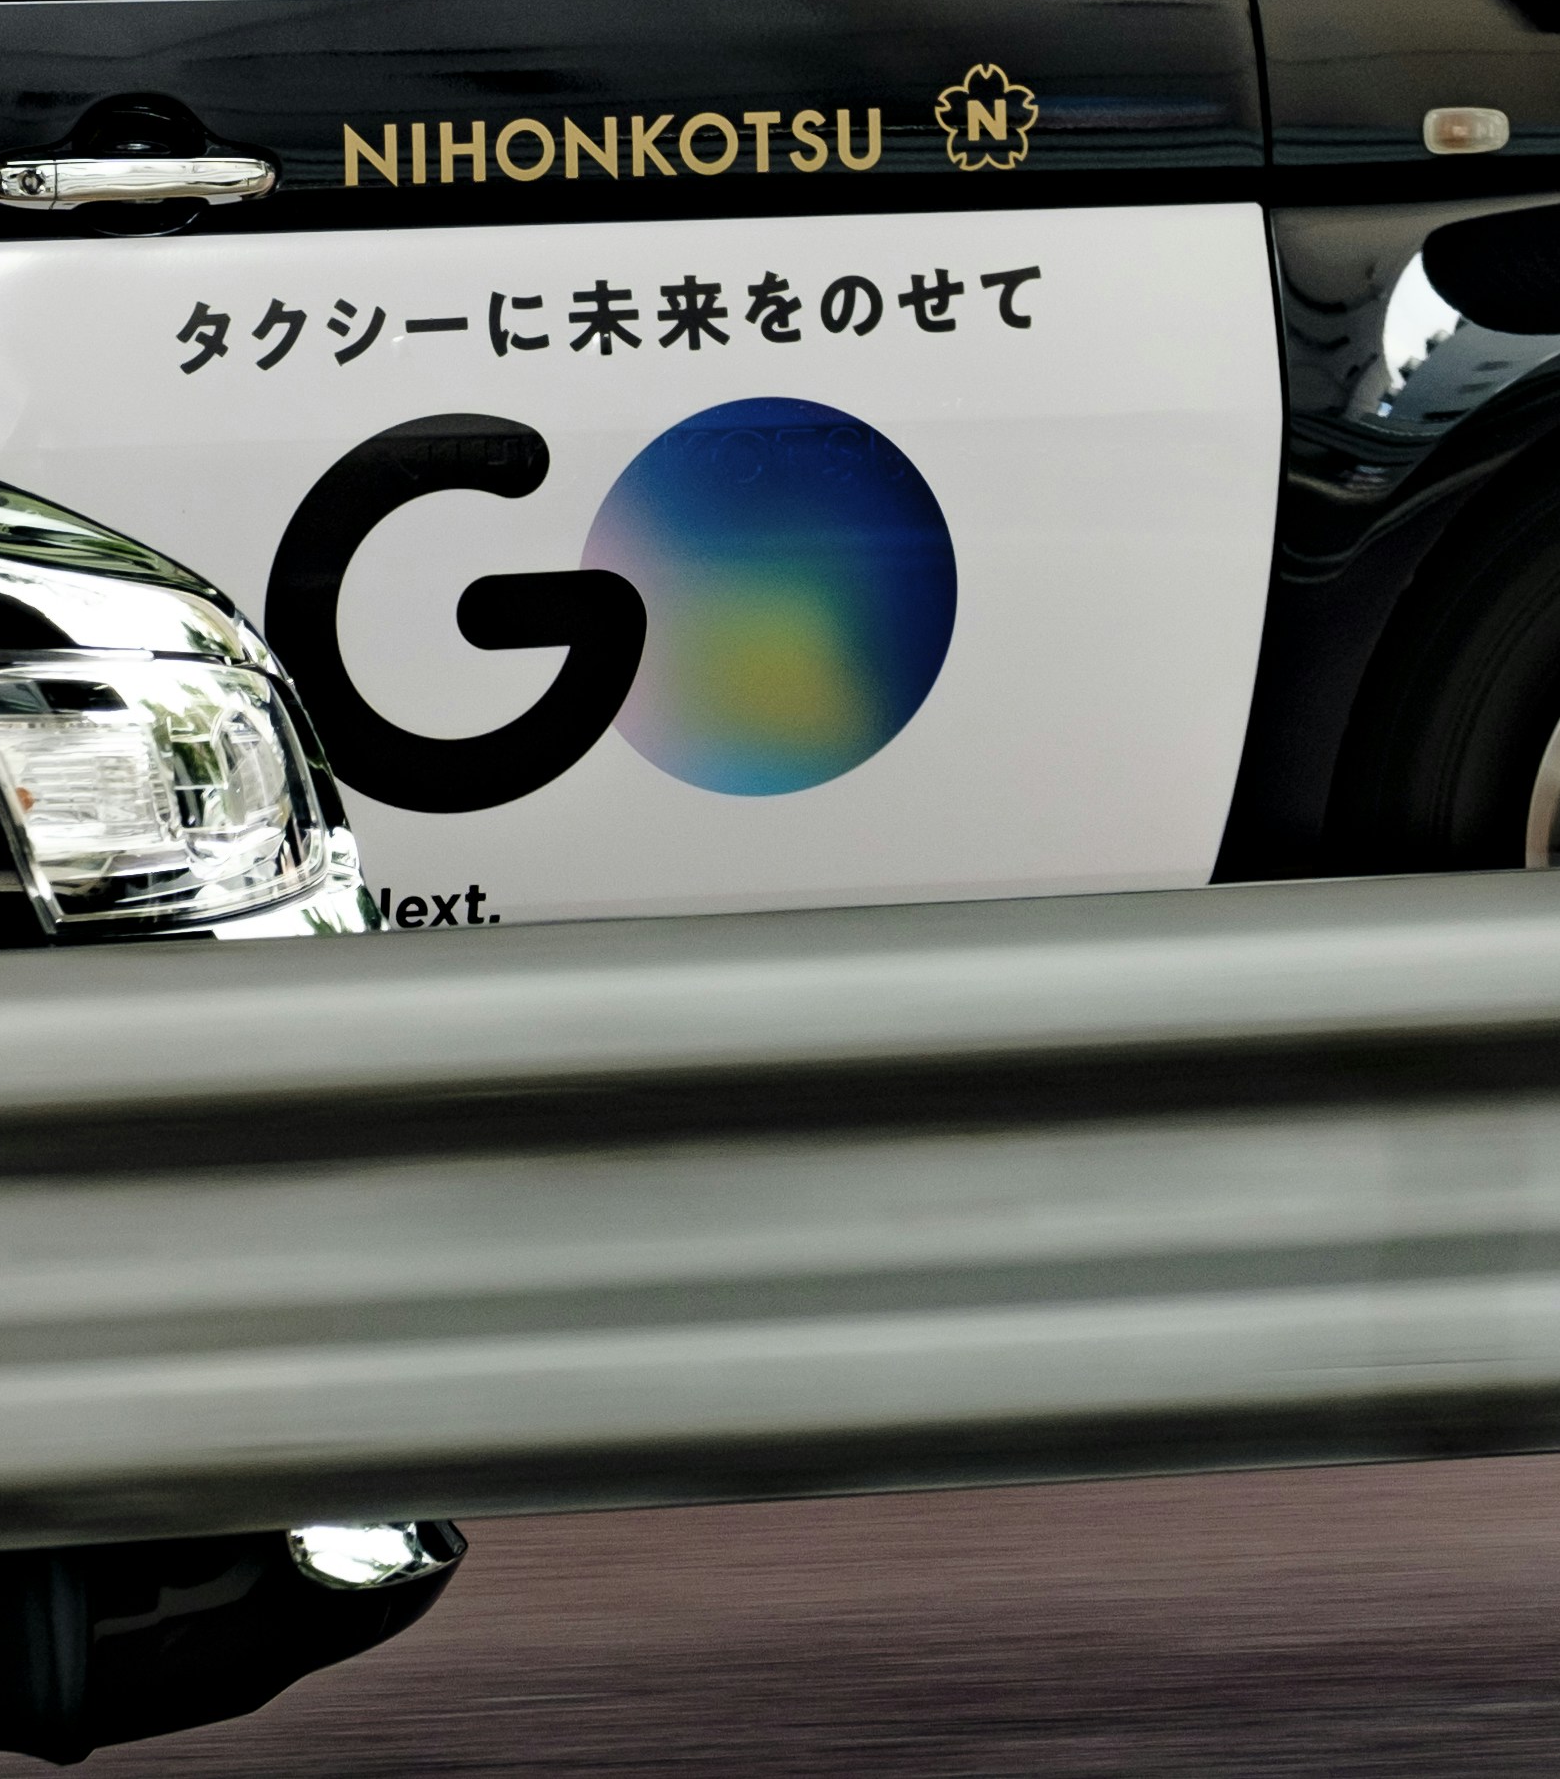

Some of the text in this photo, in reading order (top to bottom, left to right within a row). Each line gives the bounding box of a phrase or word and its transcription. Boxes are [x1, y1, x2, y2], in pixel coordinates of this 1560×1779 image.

[343, 108, 881, 186] NIHONKOTSU
[175, 264, 1043, 375] タクシーに未来をのせて
